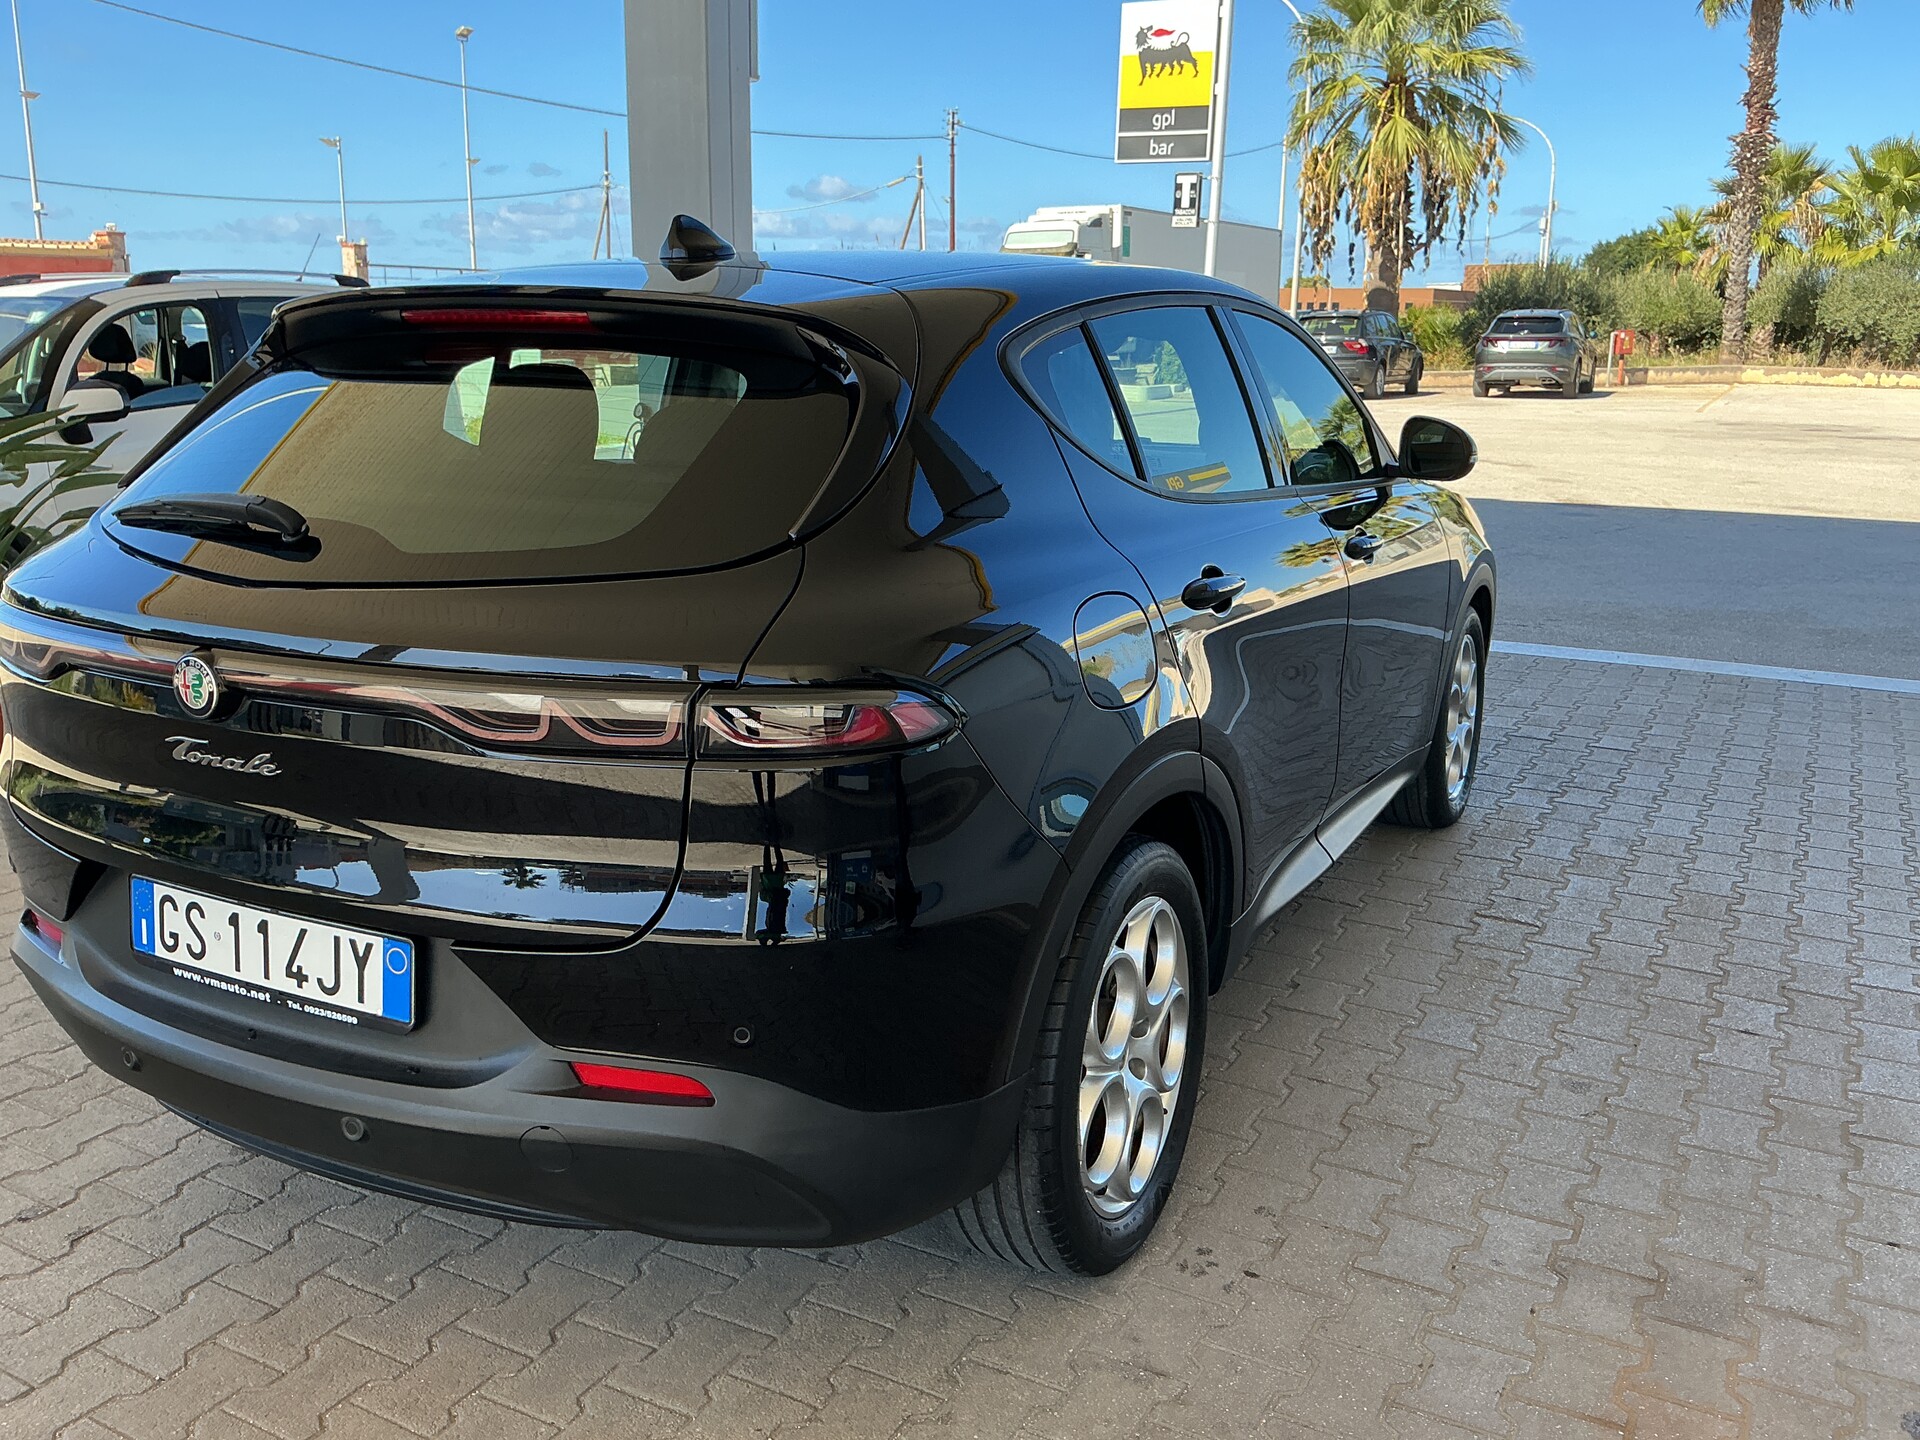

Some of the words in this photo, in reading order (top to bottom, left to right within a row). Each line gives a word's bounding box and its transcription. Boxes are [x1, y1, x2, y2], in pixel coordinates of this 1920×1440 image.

[1152, 109, 1176, 131] gpl
[1149, 139, 1175, 156] bar
[189, 659, 214, 692] ROMEO
[165, 736, 283, 776] Tonale
[173, 967, 271, 1003] www.vmauto.net
